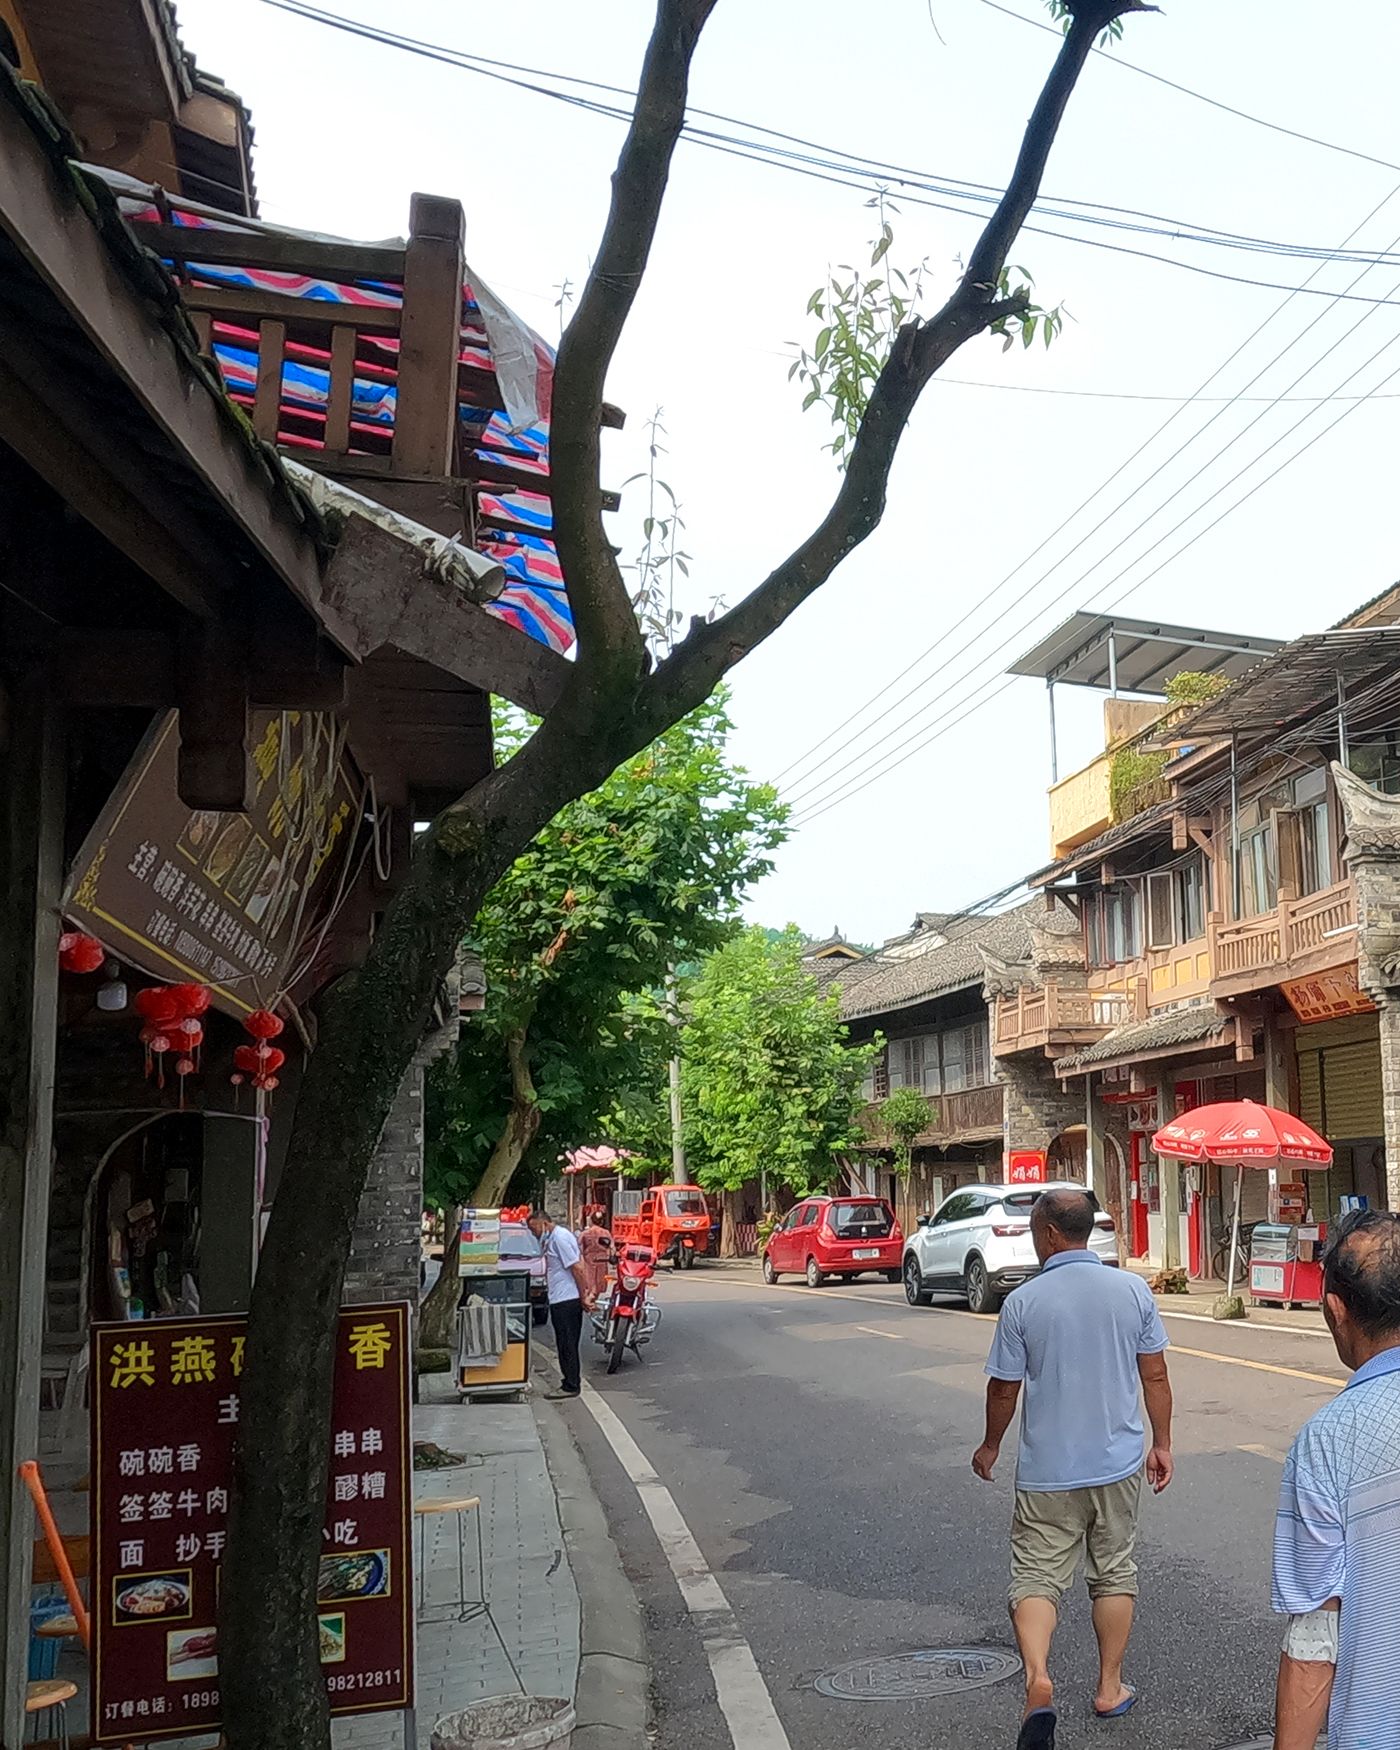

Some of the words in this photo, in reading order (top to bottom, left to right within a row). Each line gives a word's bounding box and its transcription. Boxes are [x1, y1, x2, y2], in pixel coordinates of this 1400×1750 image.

[119, 1443, 201, 1477] 碗碗香
[334, 1427, 383, 1458] 串串
[119, 1486, 228, 1522] 签签牛肉
[334, 1471, 386, 1501] 醪糟
[119, 1539, 144, 1569] 面
[175, 1531, 227, 1562] 抄手
